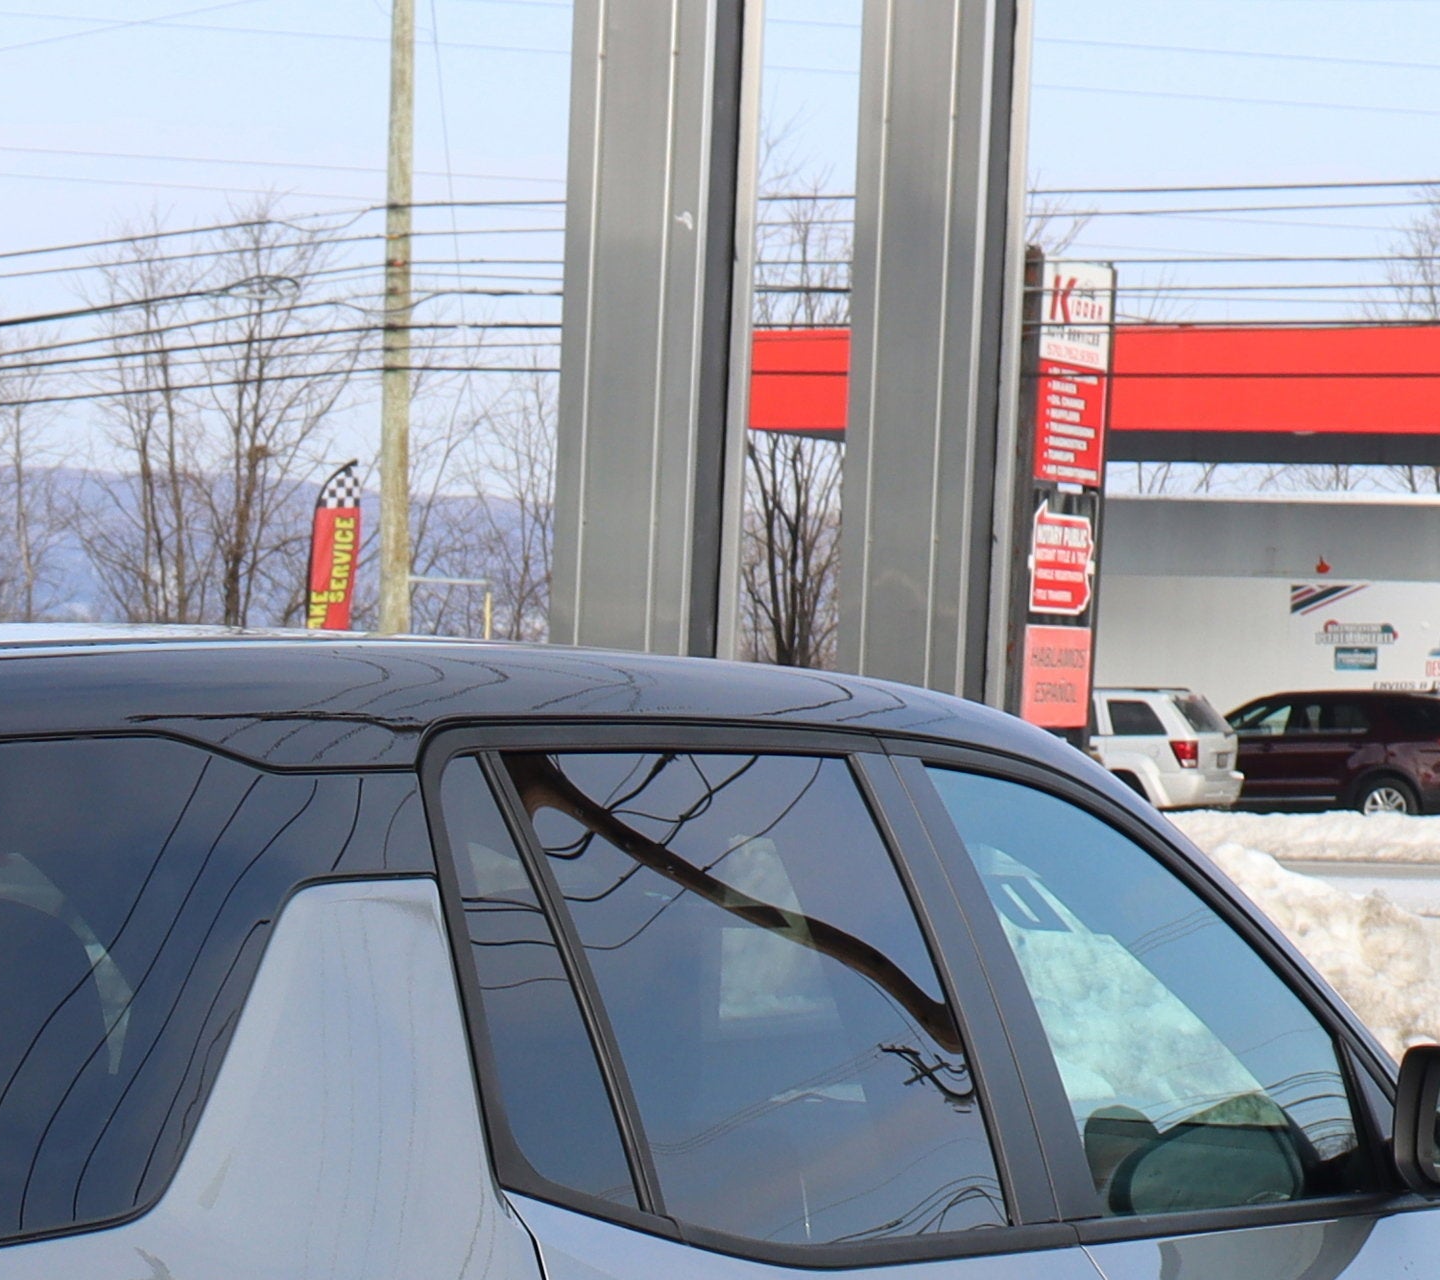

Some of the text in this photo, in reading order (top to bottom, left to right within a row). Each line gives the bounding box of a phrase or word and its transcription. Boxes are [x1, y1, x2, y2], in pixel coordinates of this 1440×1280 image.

[327, 516, 356, 604] SERVICE
[307, 590, 329, 630] AKE
[1031, 646, 1087, 669] HABLAMOS
[1033, 677, 1077, 703] ESPAÑOL
